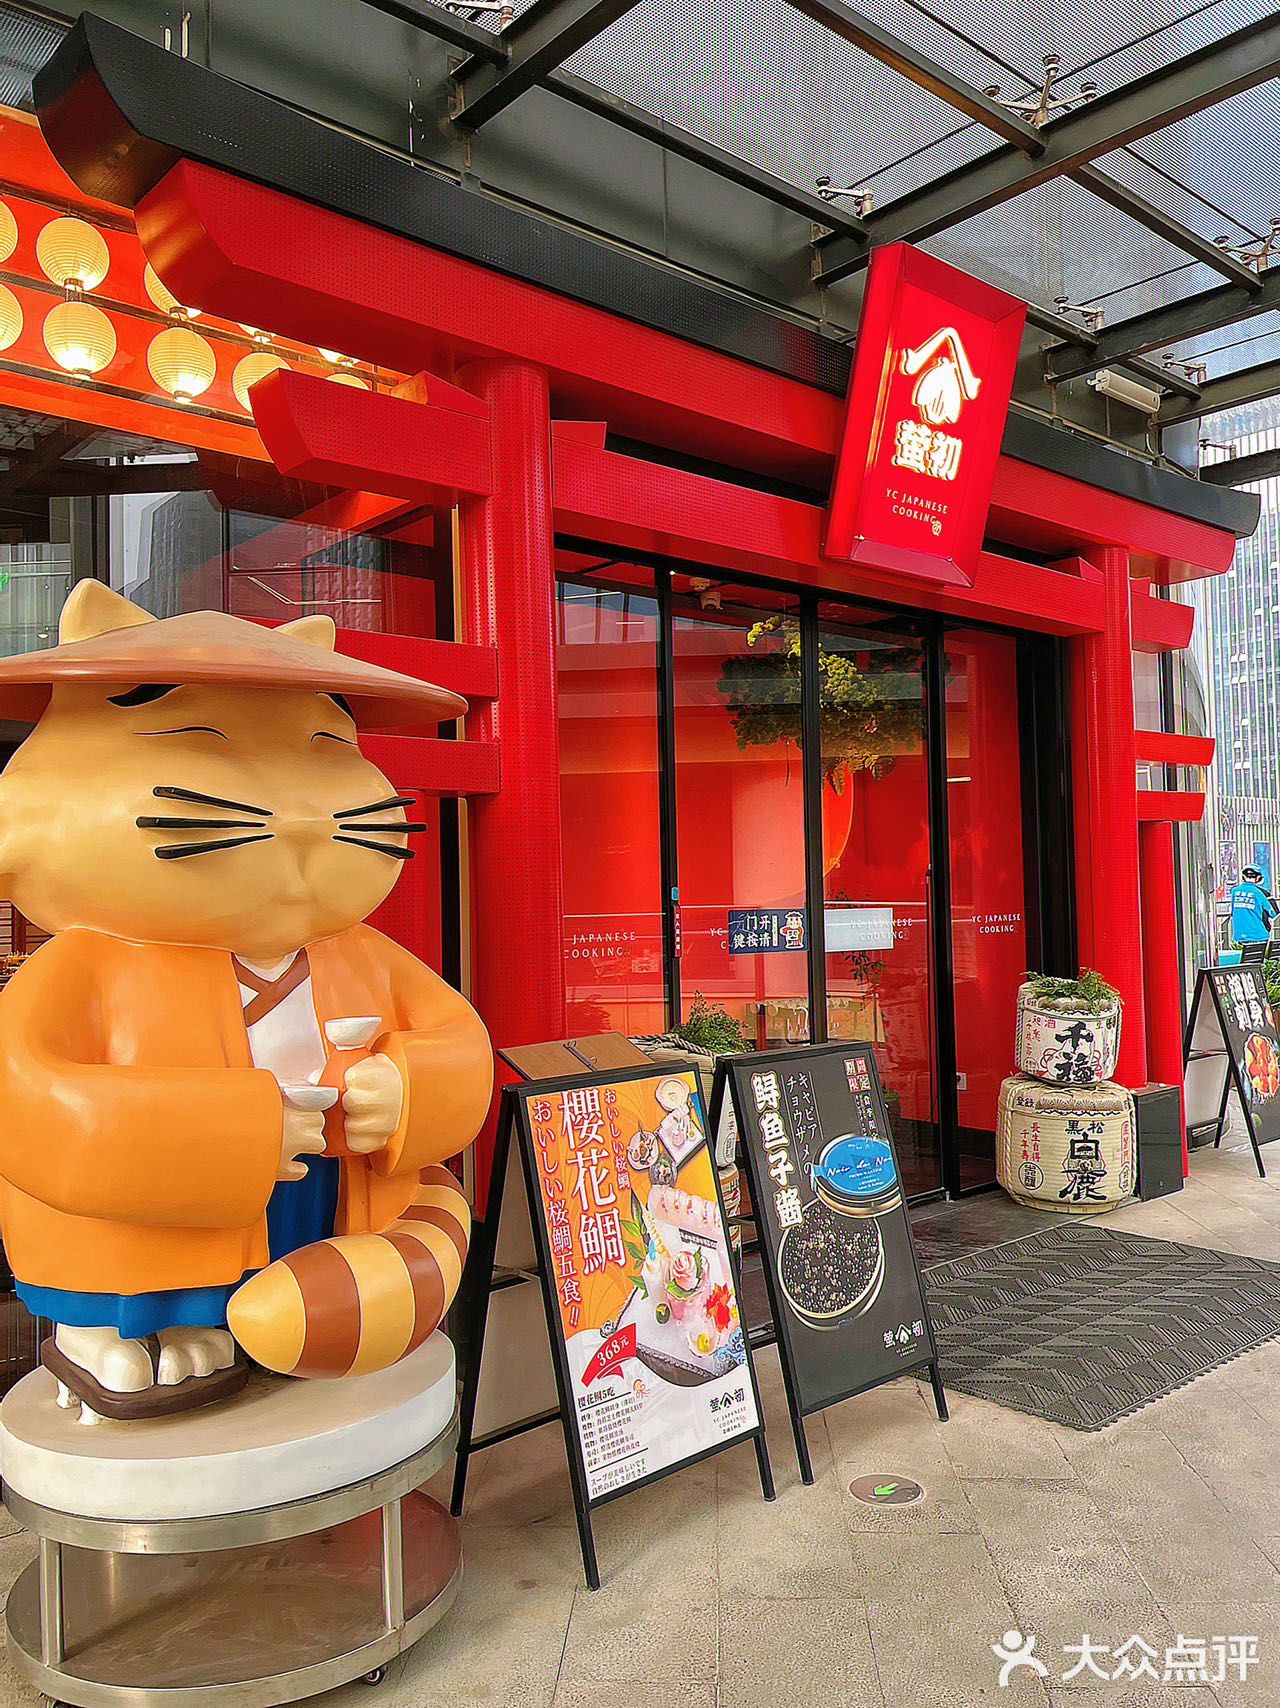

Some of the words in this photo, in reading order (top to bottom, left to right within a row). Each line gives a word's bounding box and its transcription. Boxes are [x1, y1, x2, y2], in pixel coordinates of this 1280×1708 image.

[886, 488, 899, 500] YC
[901, 493, 949, 515] JAPANESE
[892, 505, 936, 524] COOKING
[979, 924, 1014, 934] COOKING
[985, 913, 1021, 924] JAPANESE
[573, 931, 636, 945] JAPANESE
[798, 1072, 818, 1140] キャビア
[604, 1088, 631, 1190] おいしい桜鯛
[786, 1075, 814, 1178] チョウザメの
[558, 1087, 627, 1274] 櫻花鯛
[1058, 1132, 1108, 1201] 白鹿
[597, 1335, 630, 1367] 368元
